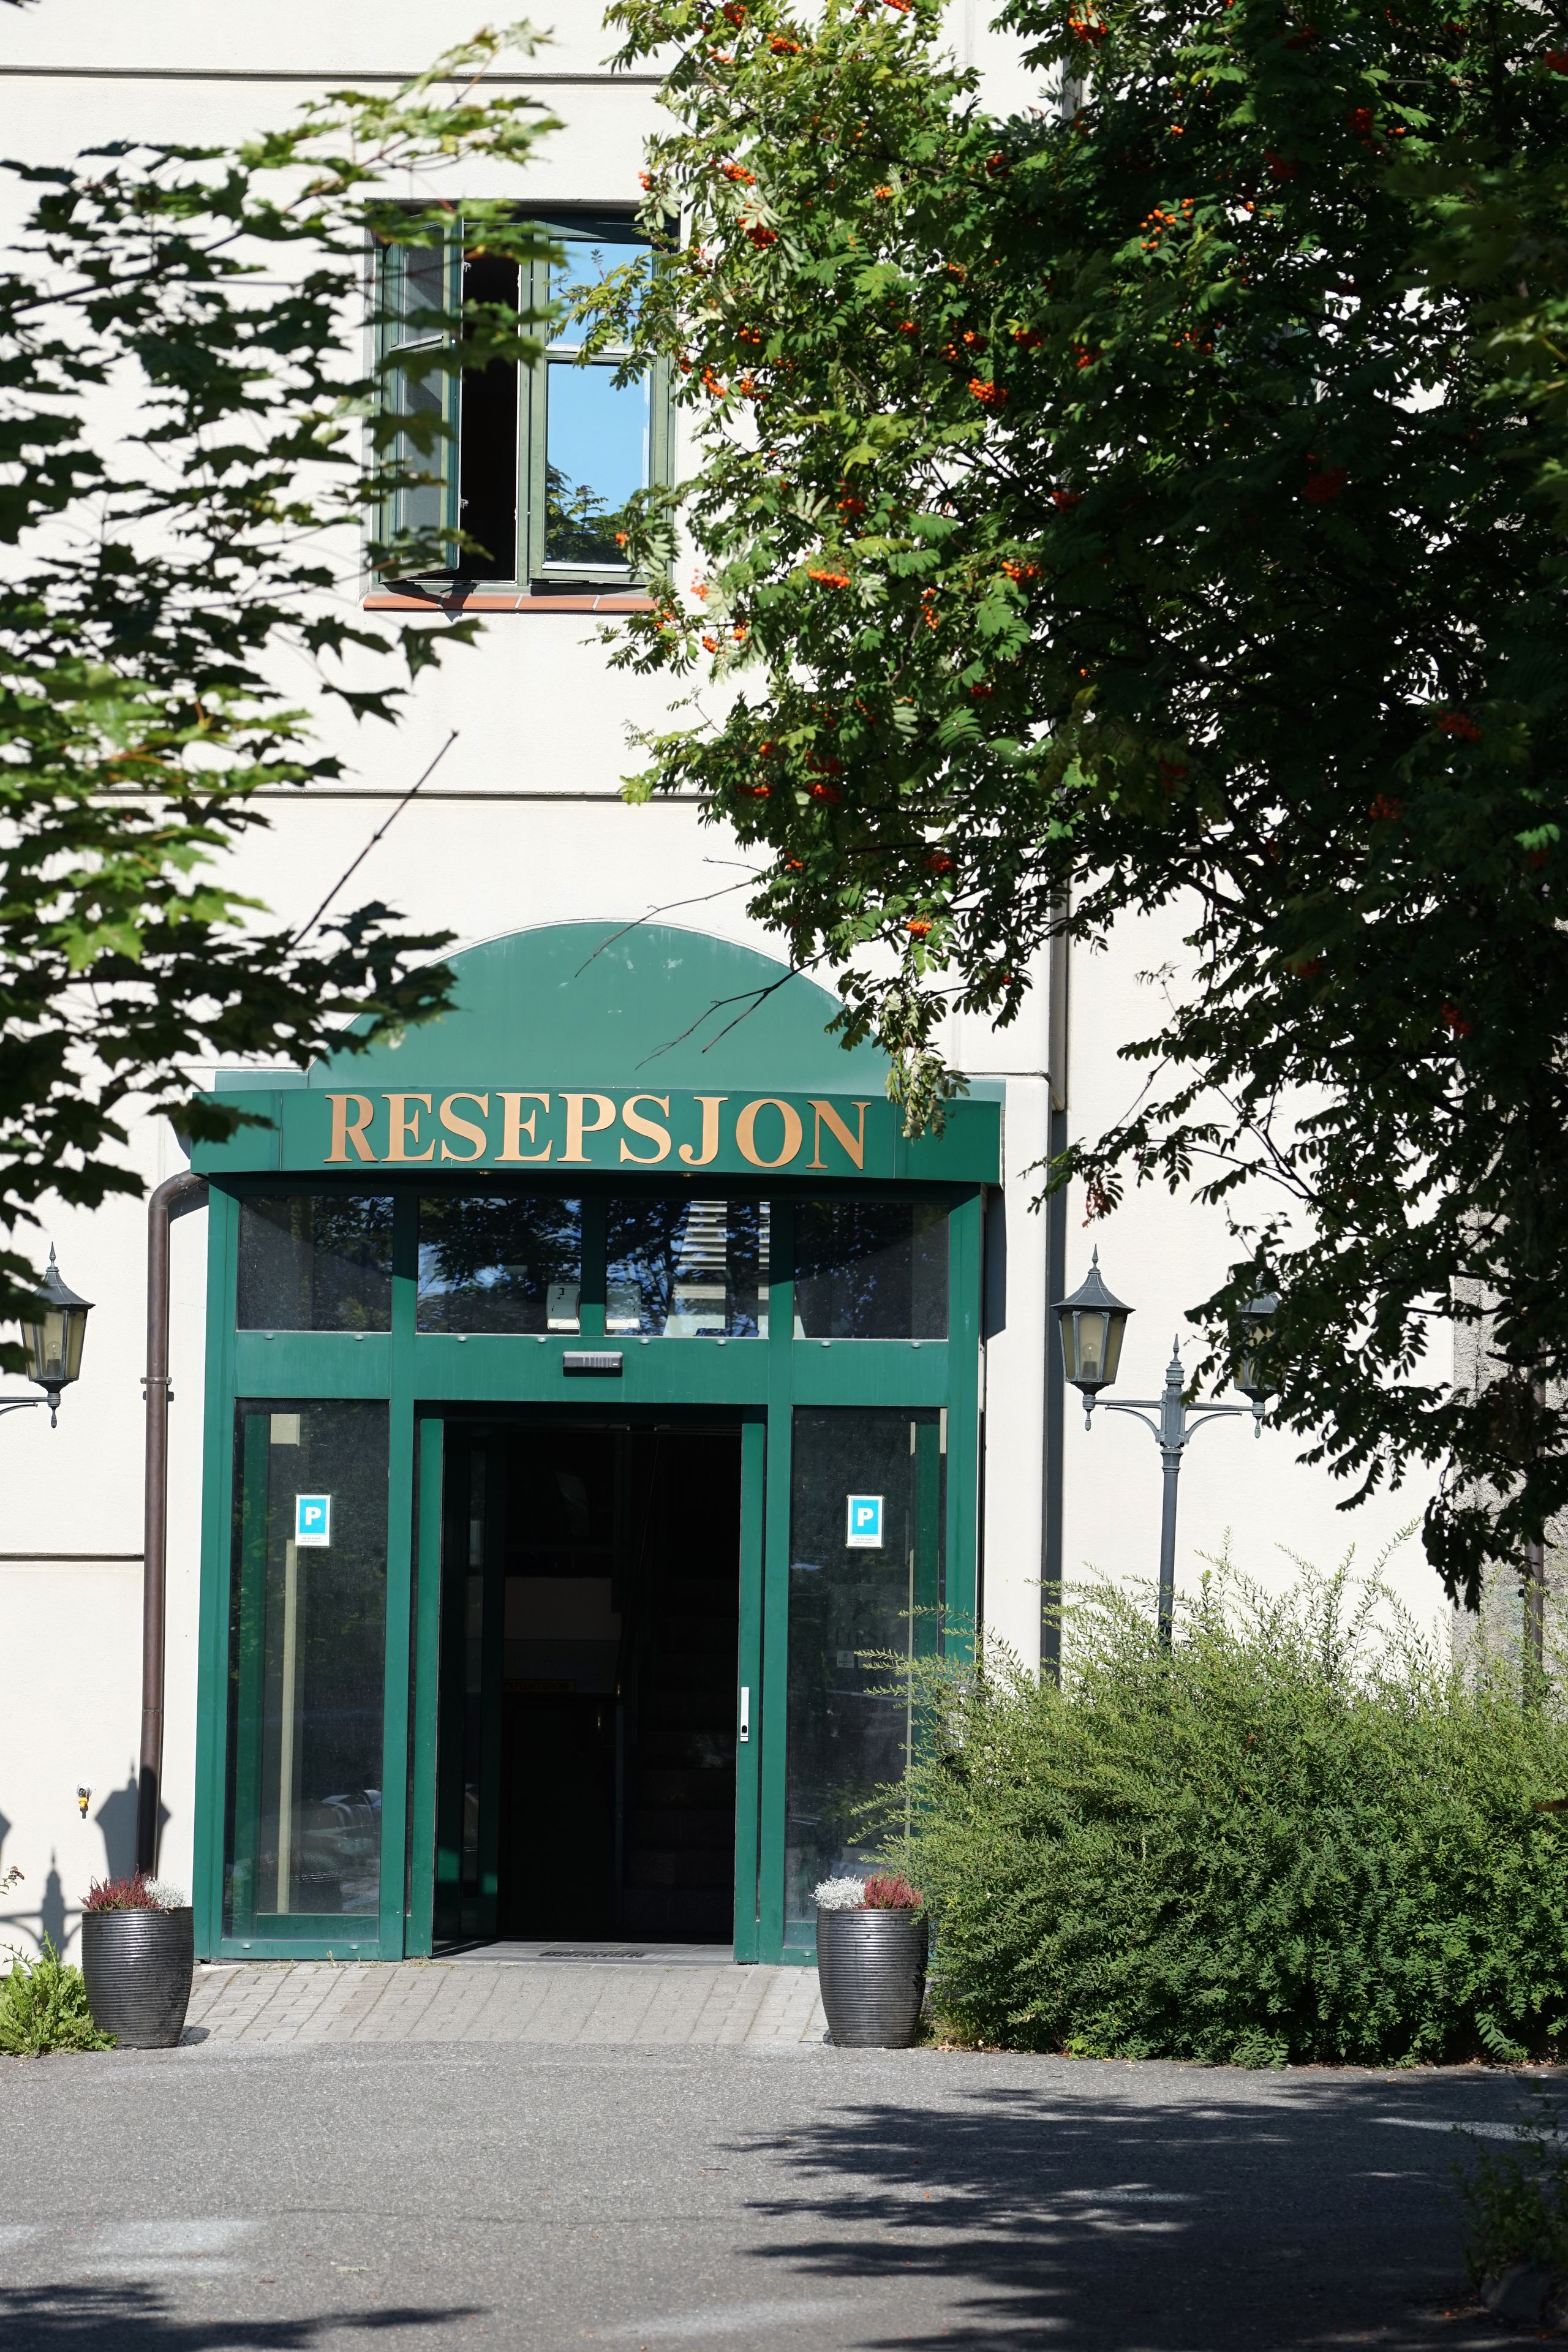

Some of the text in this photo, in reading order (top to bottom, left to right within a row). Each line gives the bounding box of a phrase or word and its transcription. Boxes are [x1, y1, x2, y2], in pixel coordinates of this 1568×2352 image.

[323, 1092, 872, 1170] RESEPSJON
[305, 1507, 322, 1526] P
[857, 1507, 873, 1526] P
